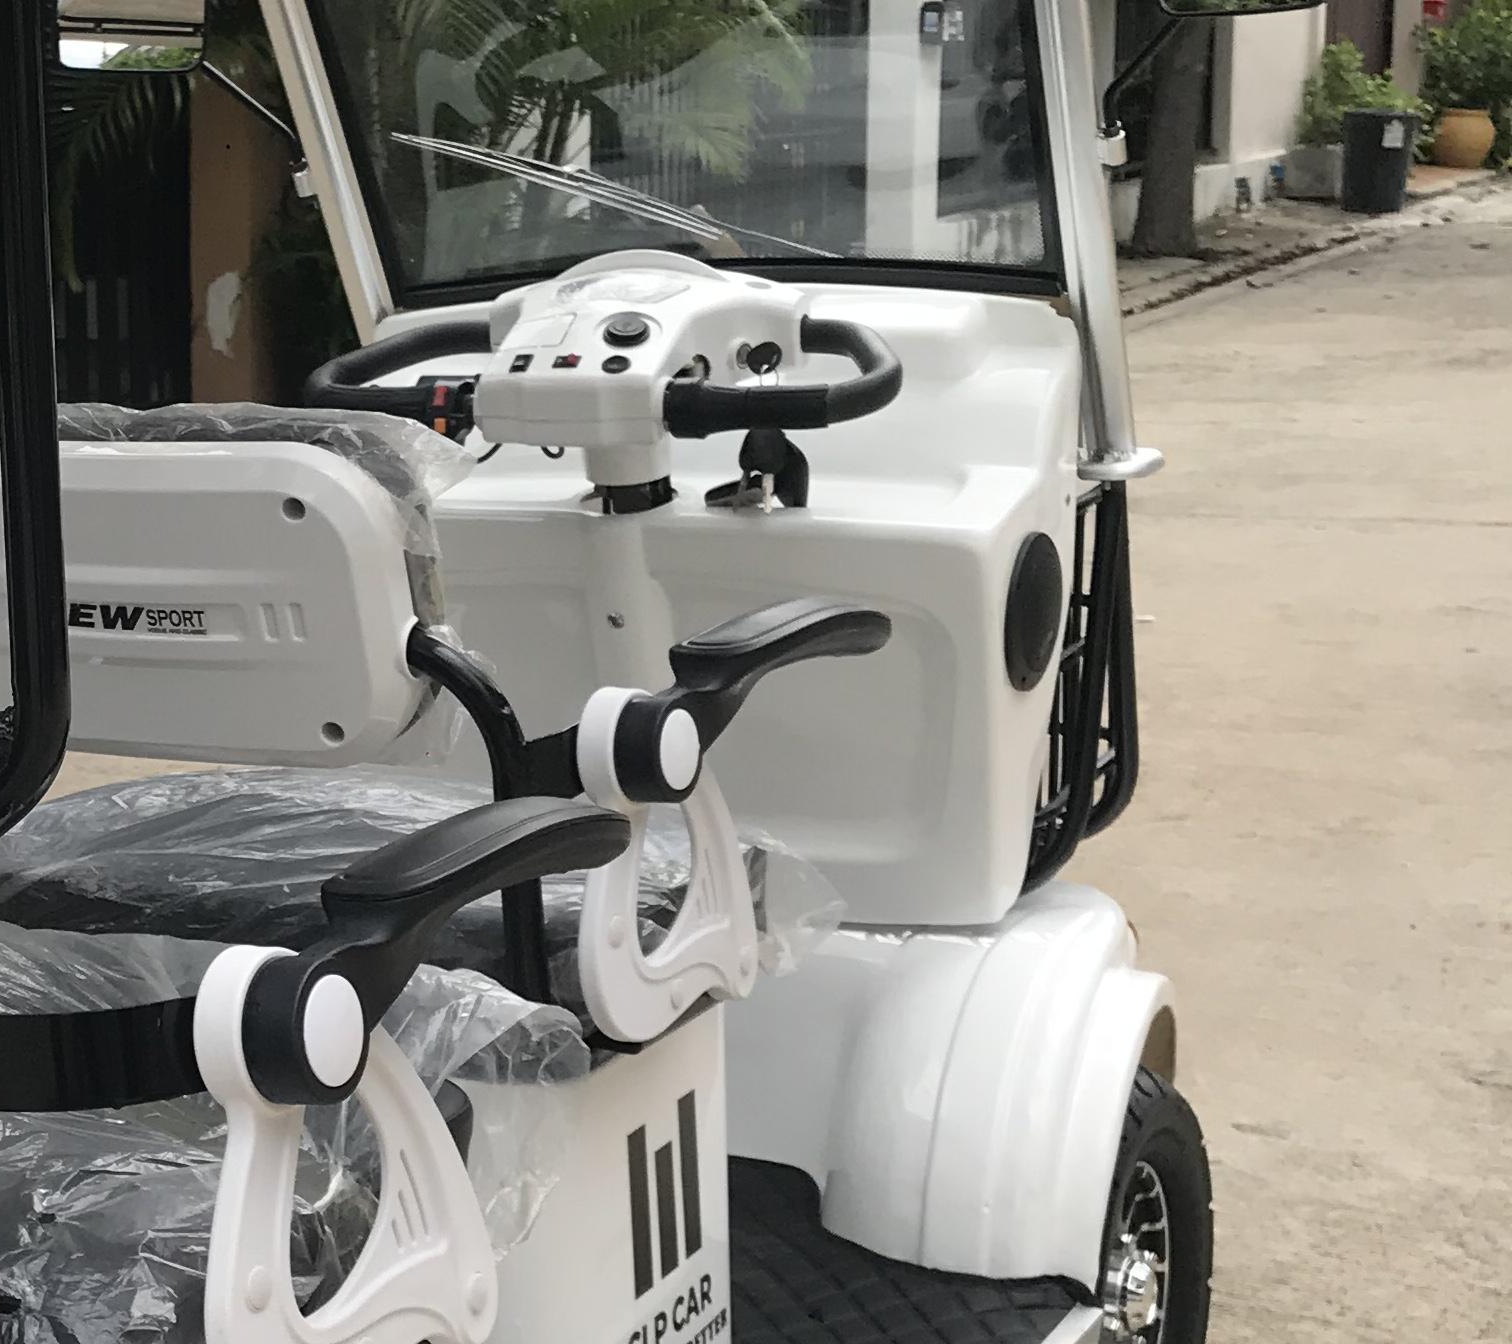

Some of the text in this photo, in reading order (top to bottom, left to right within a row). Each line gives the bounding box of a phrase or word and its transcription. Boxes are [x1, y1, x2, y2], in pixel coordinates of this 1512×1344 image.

[67, 603, 205, 631] EW SPORT
[672, 1274, 712, 1332] CAR
